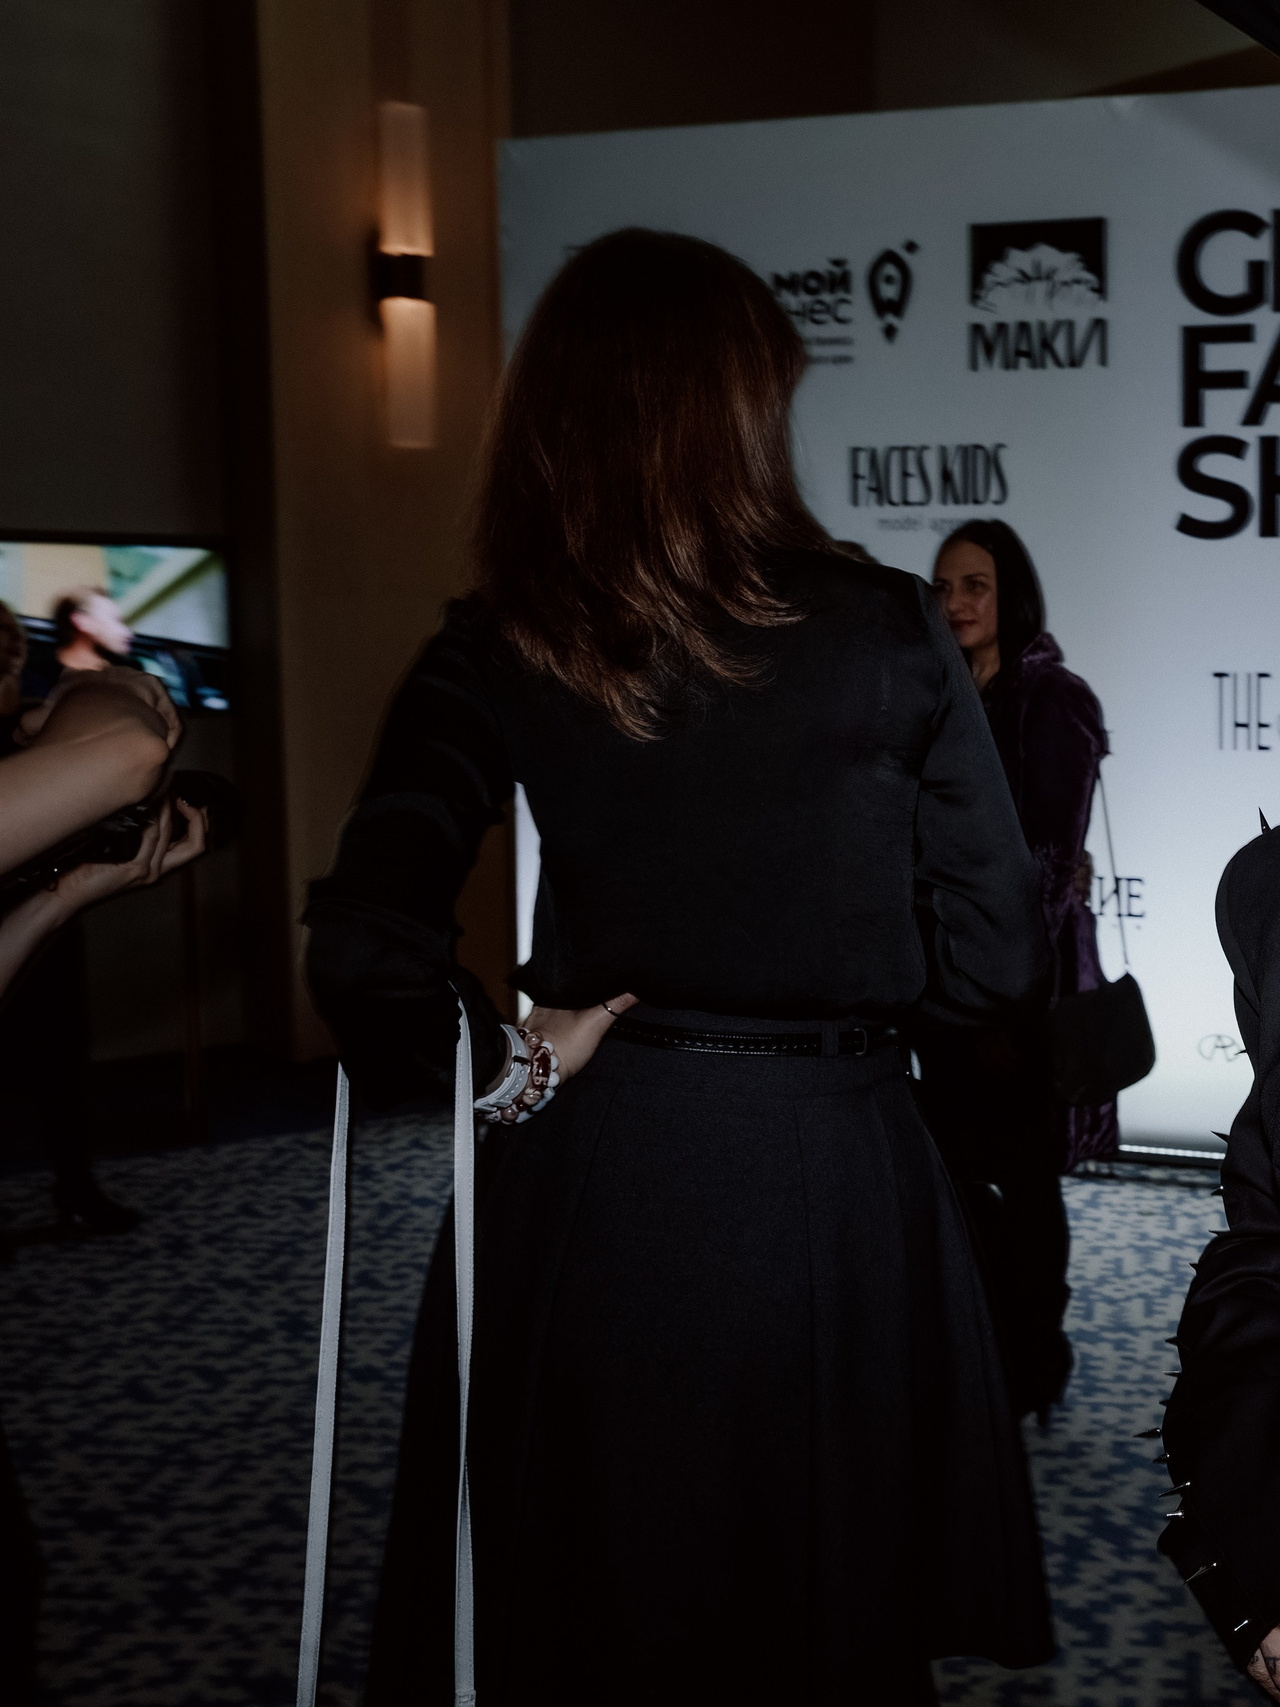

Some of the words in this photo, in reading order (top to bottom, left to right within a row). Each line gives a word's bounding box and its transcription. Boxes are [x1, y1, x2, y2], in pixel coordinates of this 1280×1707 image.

[967, 317, 1108, 372] МАКИ
[849, 446, 932, 507] FACES
[939, 443, 1009, 506] KIDS
[1212, 673, 1271, 751] THE
